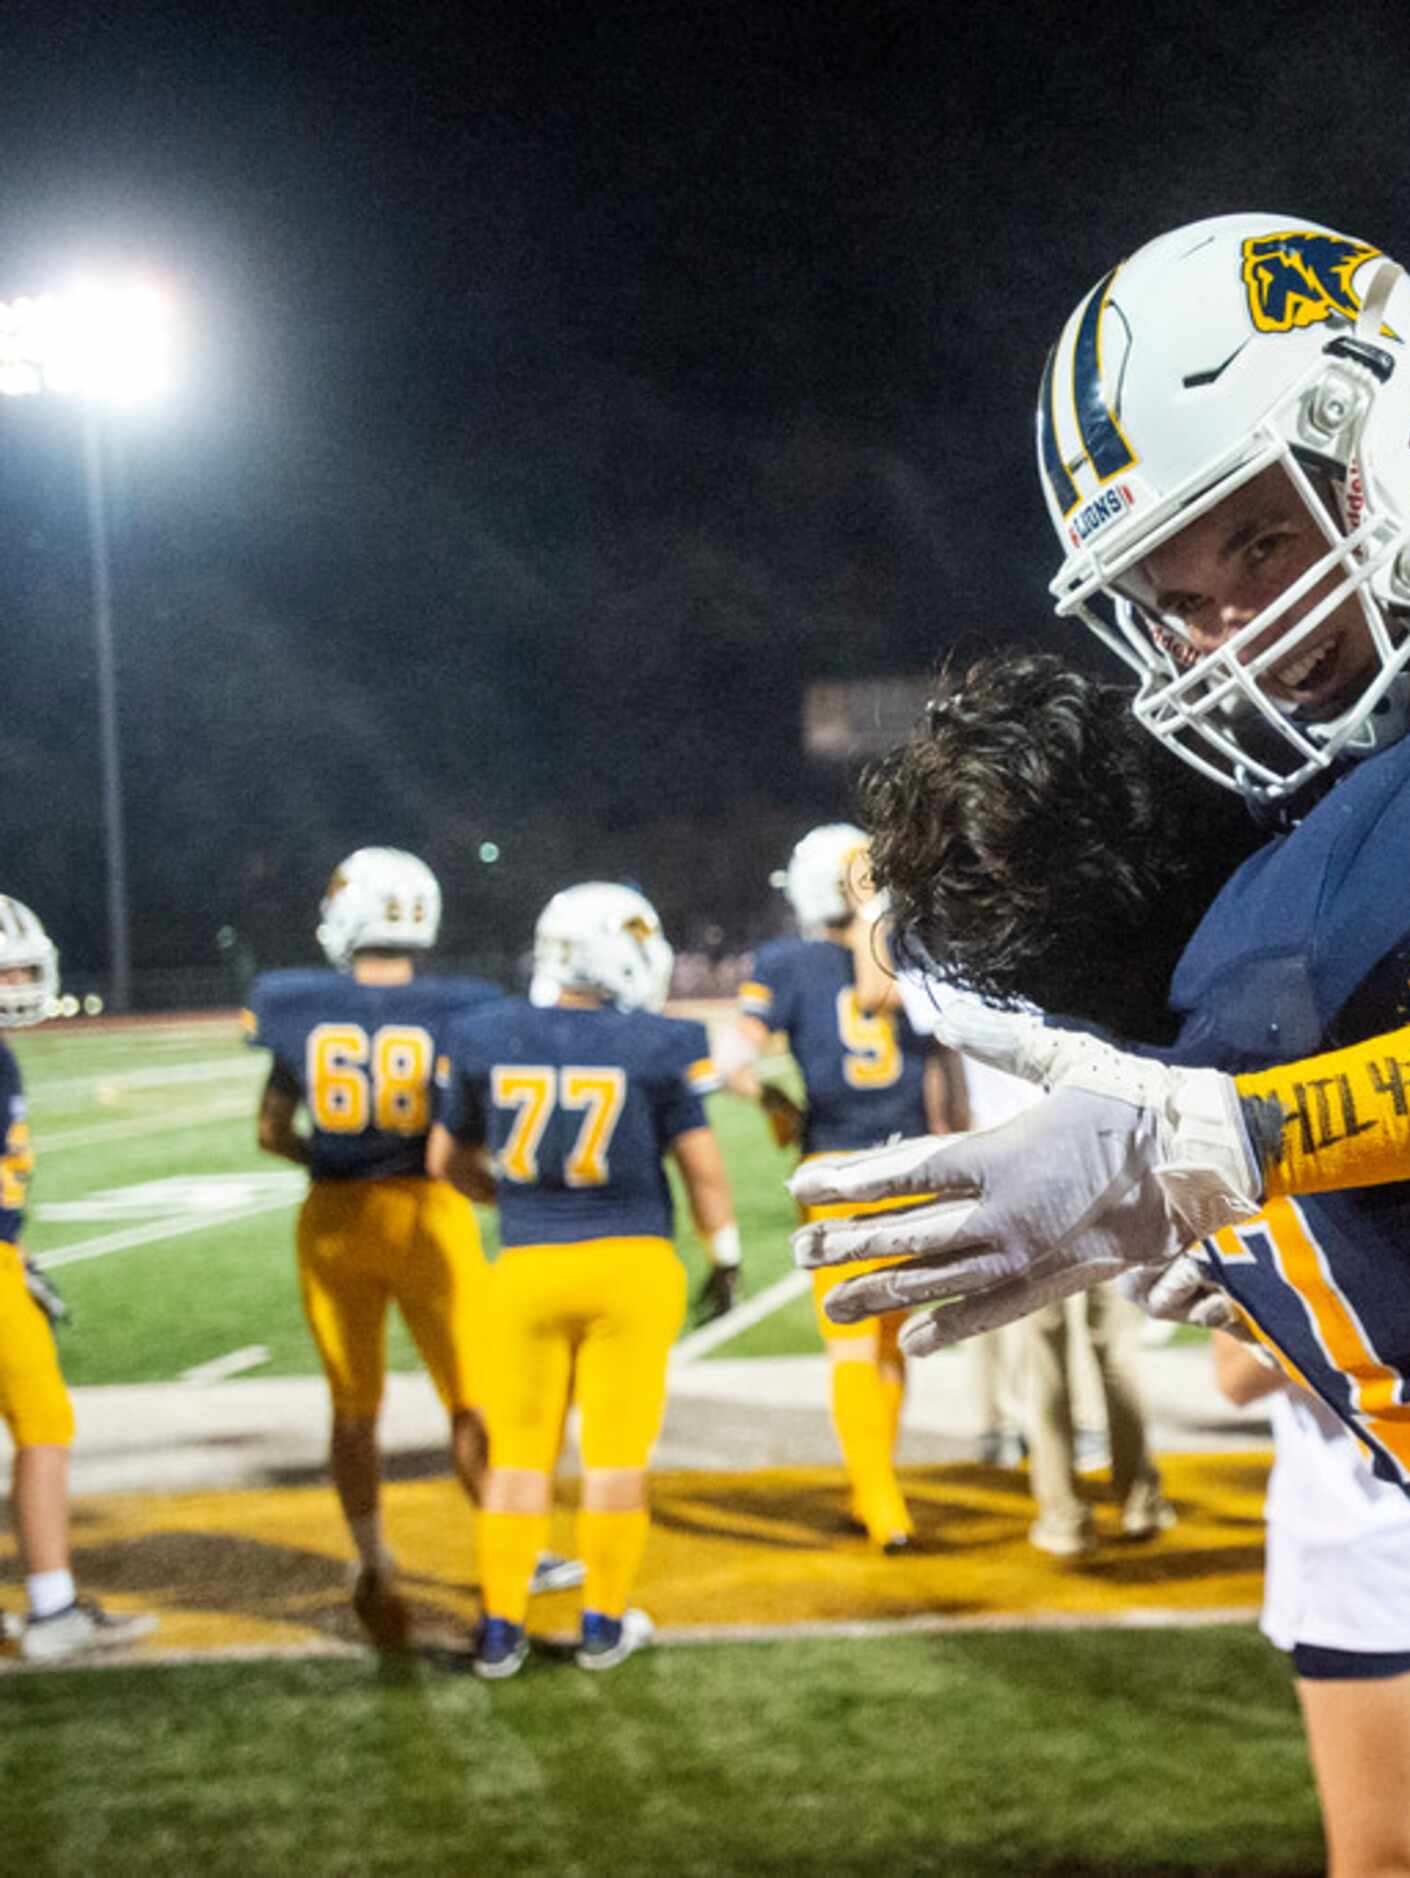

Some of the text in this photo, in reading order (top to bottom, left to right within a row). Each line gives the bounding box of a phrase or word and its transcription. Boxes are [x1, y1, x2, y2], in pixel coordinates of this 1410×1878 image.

[1073, 488, 1122, 539] LIONS
[306, 1022, 434, 1135] 68
[837, 986, 904, 1090] 5
[490, 1064, 627, 1188] 77
